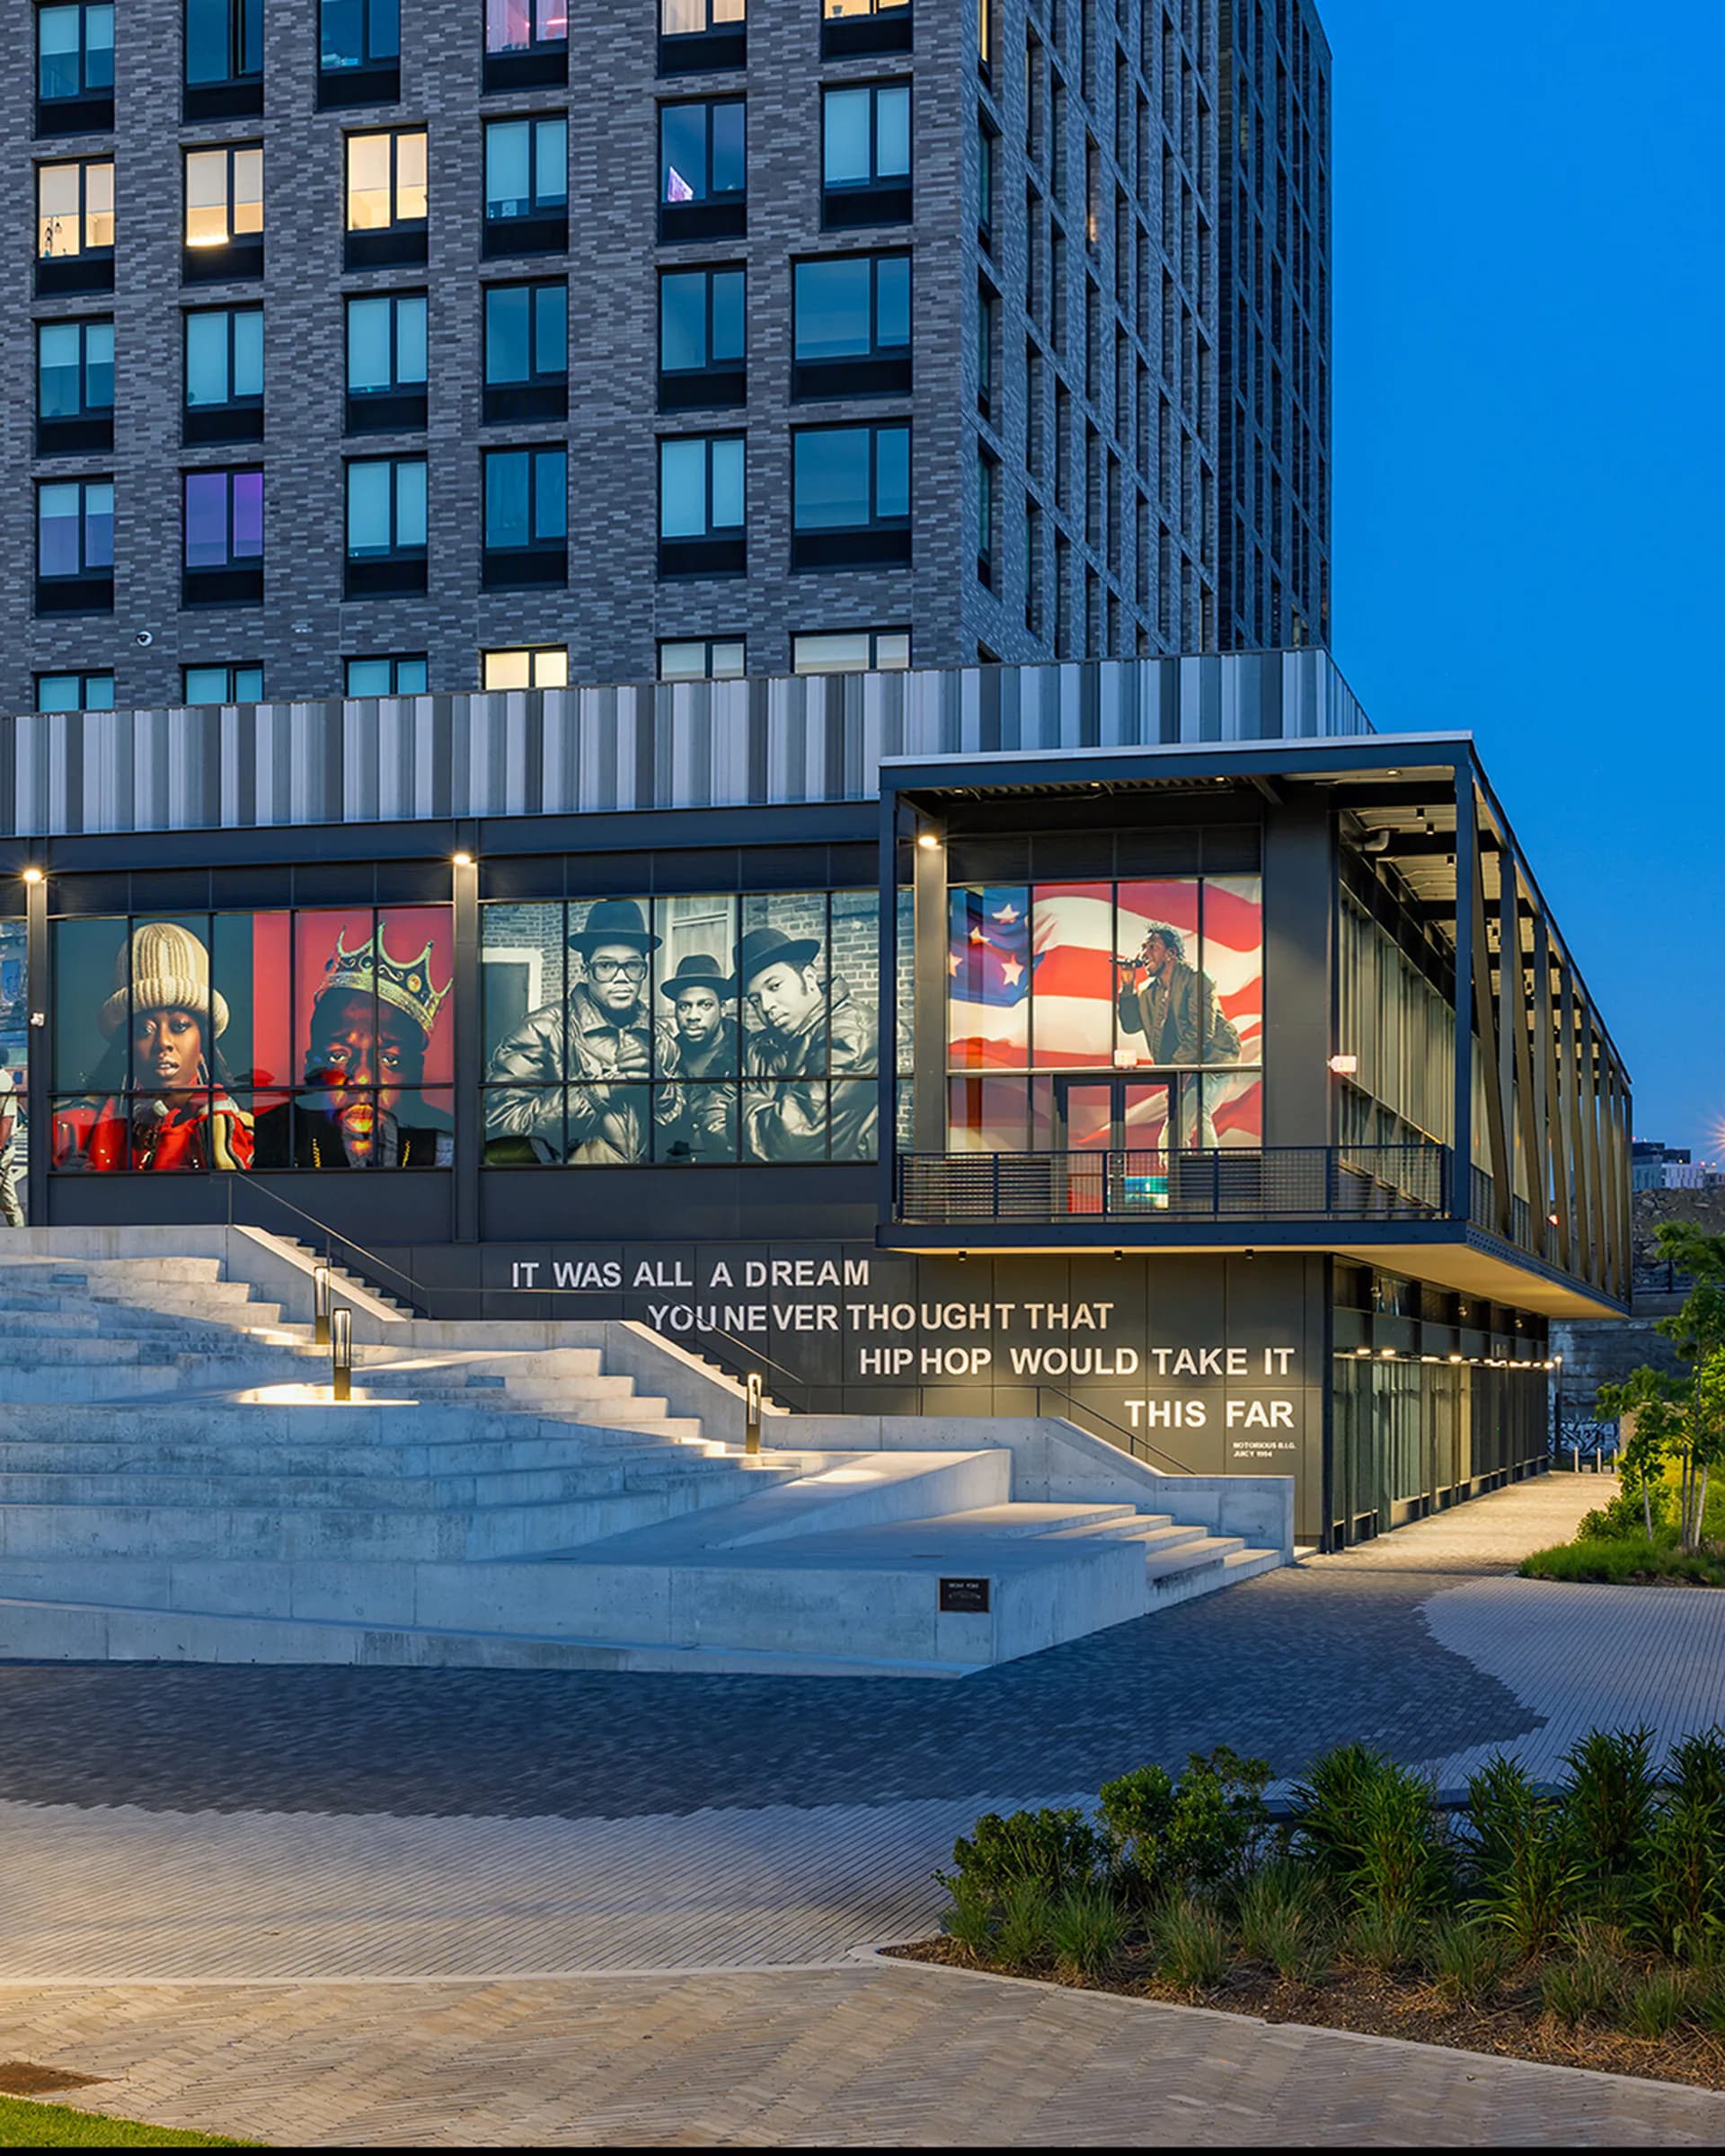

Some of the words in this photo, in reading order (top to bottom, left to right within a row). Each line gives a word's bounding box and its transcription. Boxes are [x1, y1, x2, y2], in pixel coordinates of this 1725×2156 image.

[513, 1263, 539, 1287] IT
[553, 1262, 621, 1287] WAS
[633, 1262, 693, 1287] ALL
[710, 1262, 733, 1287] A
[747, 1260, 868, 1286] DREAM
[649, 1305, 716, 1331] YOU
[725, 1304, 838, 1330] NEVER
[846, 1303, 1015, 1330] THOUGHT
[1024, 1303, 1113, 1330] THAT
[861, 1349, 913, 1374] HIP
[922, 1348, 991, 1374] HOP
[1011, 1348, 1138, 1374] WOULD
[1152, 1348, 1247, 1374] TAKE
[1265, 1348, 1294, 1374] IT
[1125, 1401, 1206, 1427] THIS
[1226, 1401, 1294, 1427] FAR
